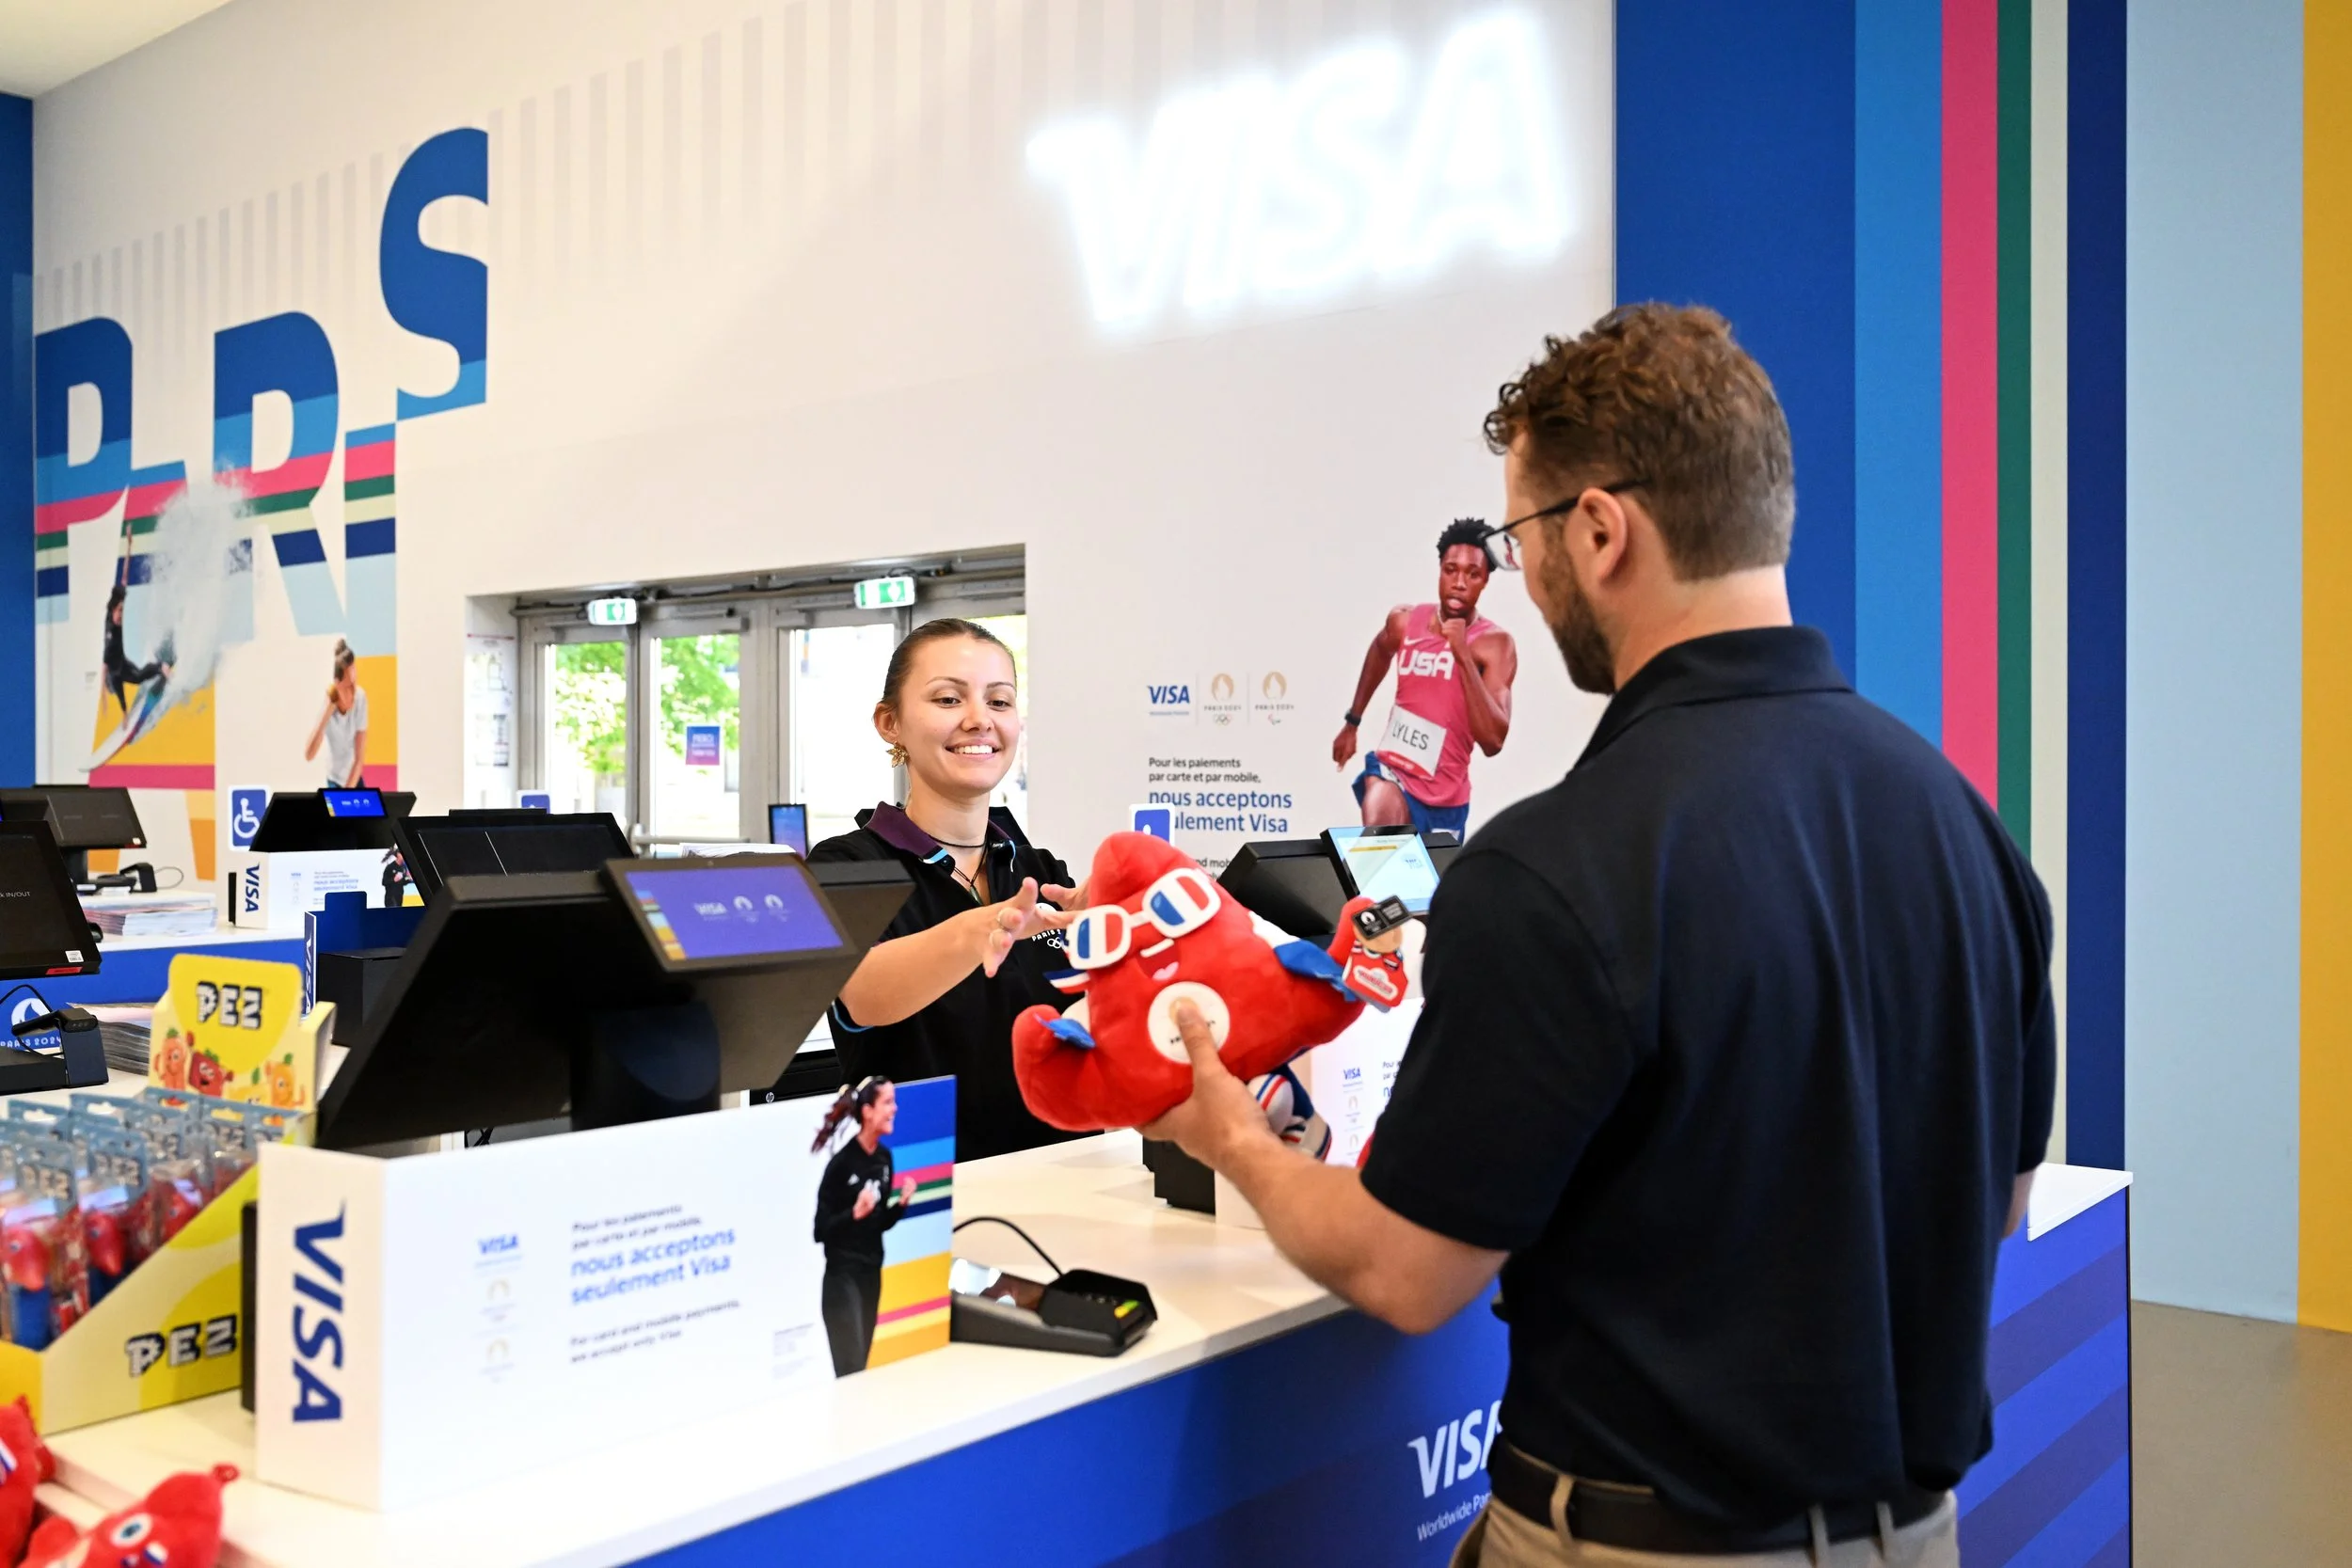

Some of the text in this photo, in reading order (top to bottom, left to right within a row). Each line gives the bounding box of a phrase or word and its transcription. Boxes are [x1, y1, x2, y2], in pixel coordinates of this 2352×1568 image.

[1027, 13, 1573, 325] VISA
[1399, 649, 1455, 680] USA
[1147, 685, 1190, 705] VISA
[1392, 721, 1429, 750] LYLES
[1149, 757, 1241, 769] Pour les paiements
[1149, 773, 1165, 783] par
[1167, 772, 1191, 783] carte
[1193, 772, 1203, 783] et
[1205, 773, 1221, 784] par
[1149, 790, 1293, 811] nous acceptons
[1174, 812, 1288, 832] lement Visa
[246, 862, 260, 912] VISA
[1031, 929, 1056, 942] PARIS
[197, 981, 262, 1030] PEZ
[571, 1228, 736, 1276] nous acceptons
[571, 1255, 731, 1305] seulement Visa
[291, 1198, 345, 1422] VISA
[125, 1313, 237, 1377] PEZ
[1417, 1500, 1472, 1542] Worldwide
